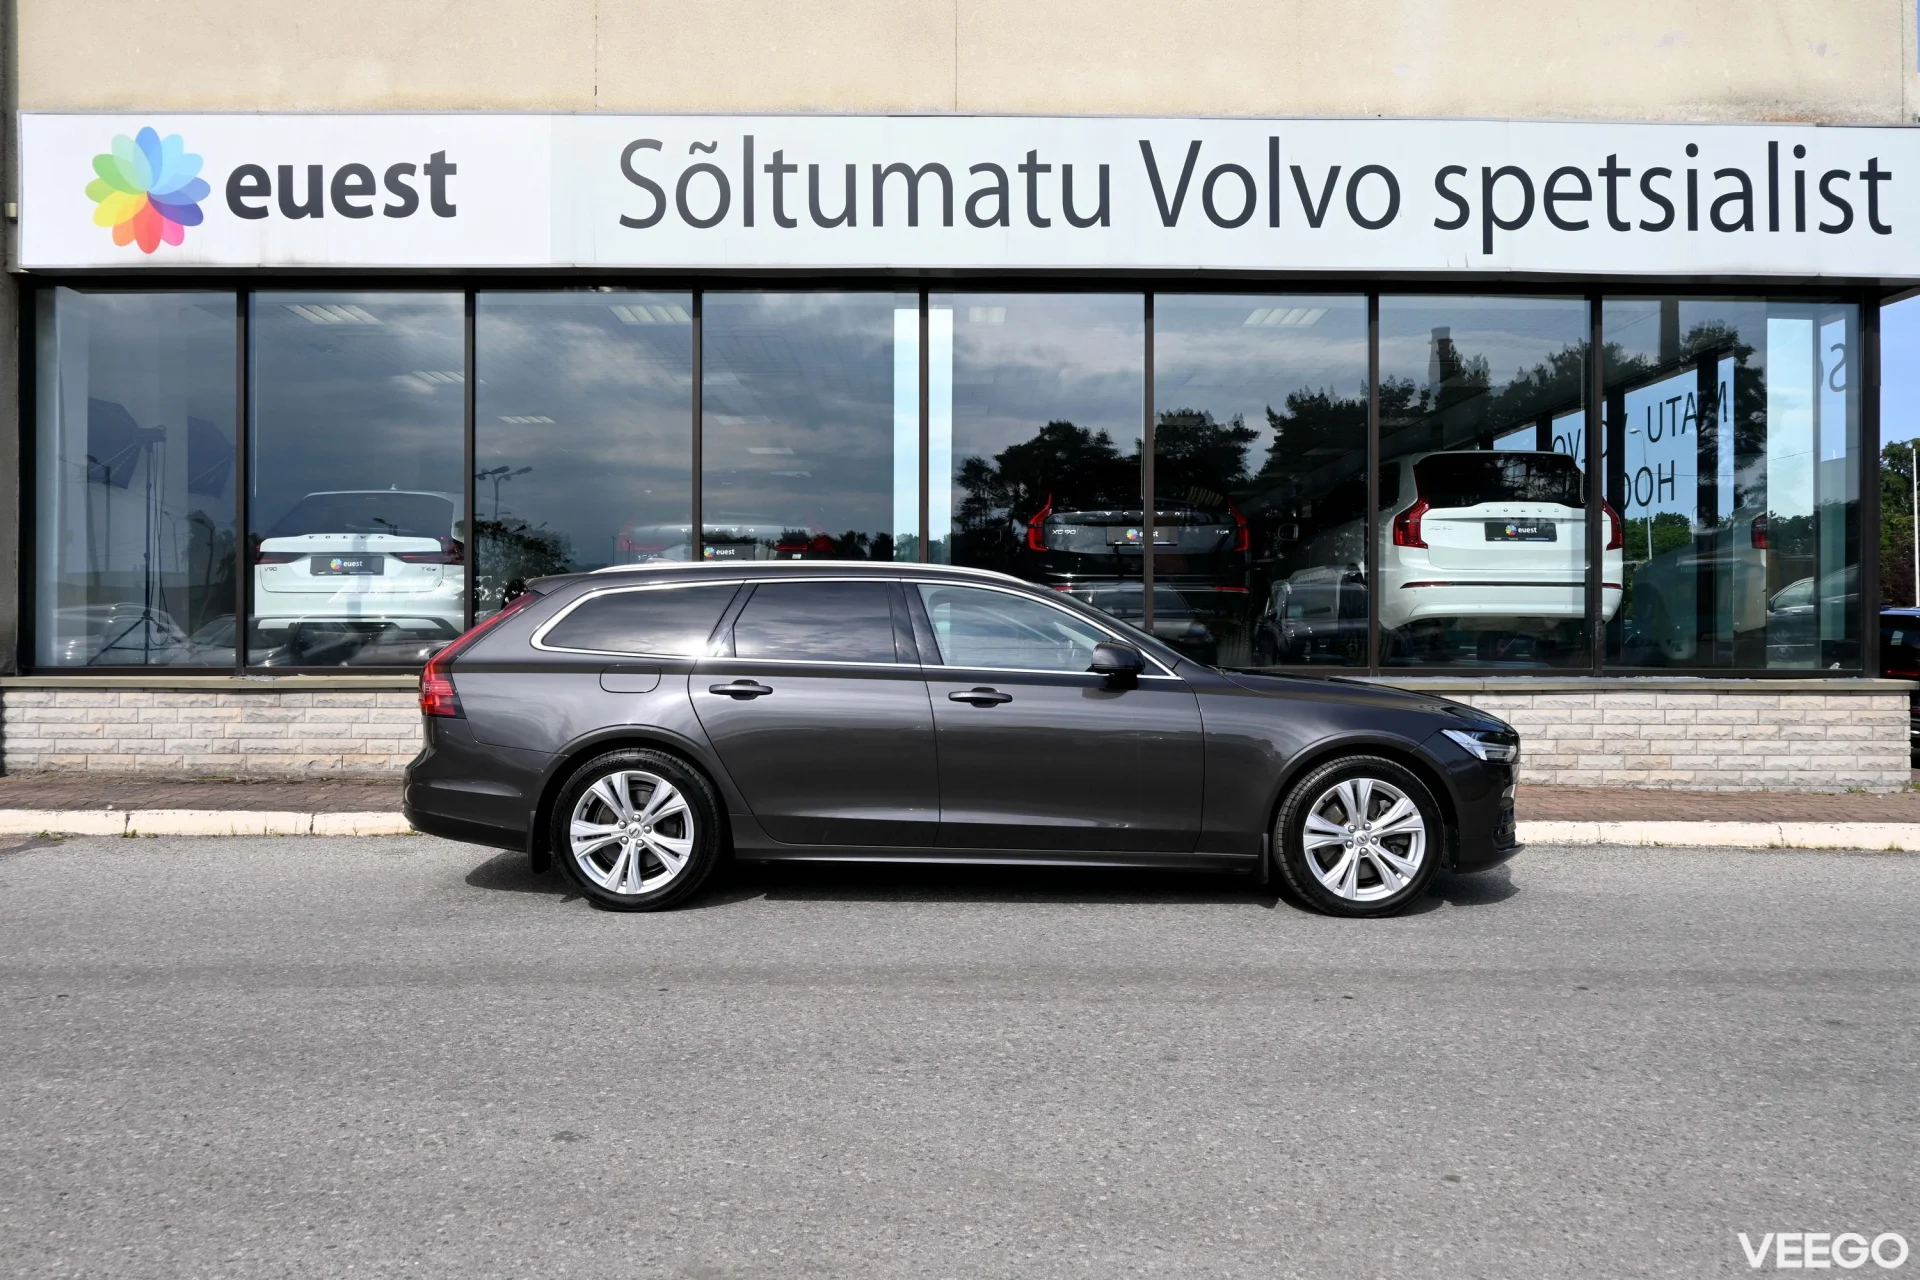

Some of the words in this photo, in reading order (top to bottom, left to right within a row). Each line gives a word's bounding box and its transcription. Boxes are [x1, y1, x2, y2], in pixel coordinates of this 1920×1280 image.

[226, 151, 457, 220] euest
[619, 134, 1111, 230] Sõltumatu
[1138, 135, 1401, 231] Volvo
[1433, 140, 1893, 255] spetsialist
[1518, 526, 1538, 534] euest
